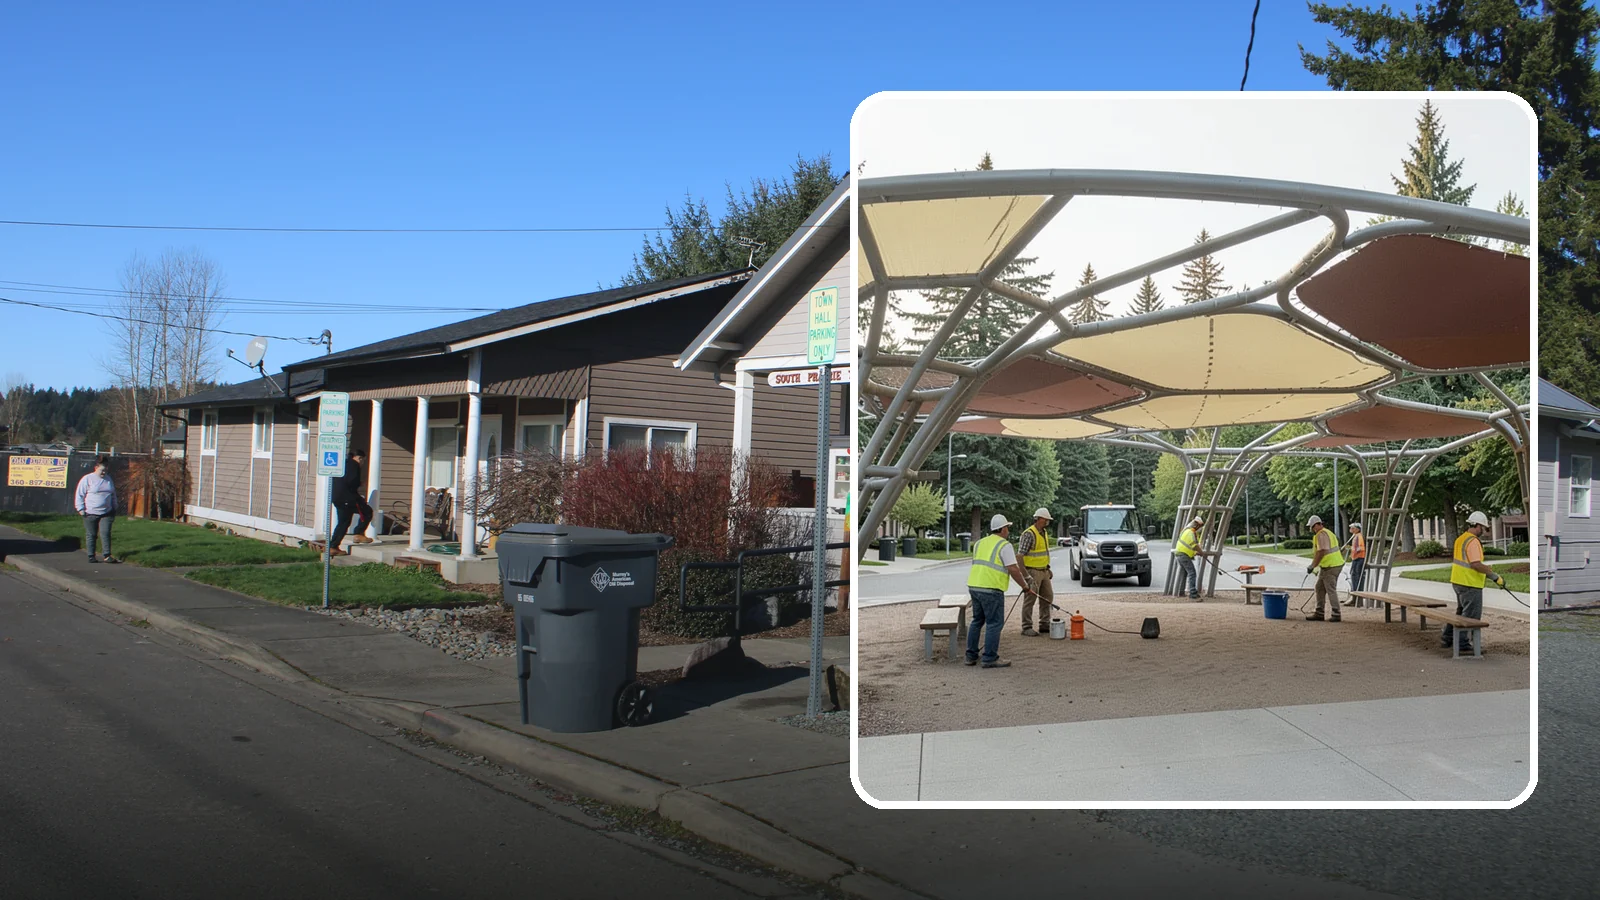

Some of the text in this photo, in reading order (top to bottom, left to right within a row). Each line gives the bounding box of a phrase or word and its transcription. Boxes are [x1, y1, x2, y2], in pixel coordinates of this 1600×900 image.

[815, 294, 833, 308] TOWN
[814, 311, 831, 324] HALL
[810, 326, 836, 340] PARKING
[814, 344, 831, 357] ONLY
[775, 373, 801, 384] SOUTH
[807, 371, 842, 382] PRIE
[325, 420, 340, 428] ONLY
